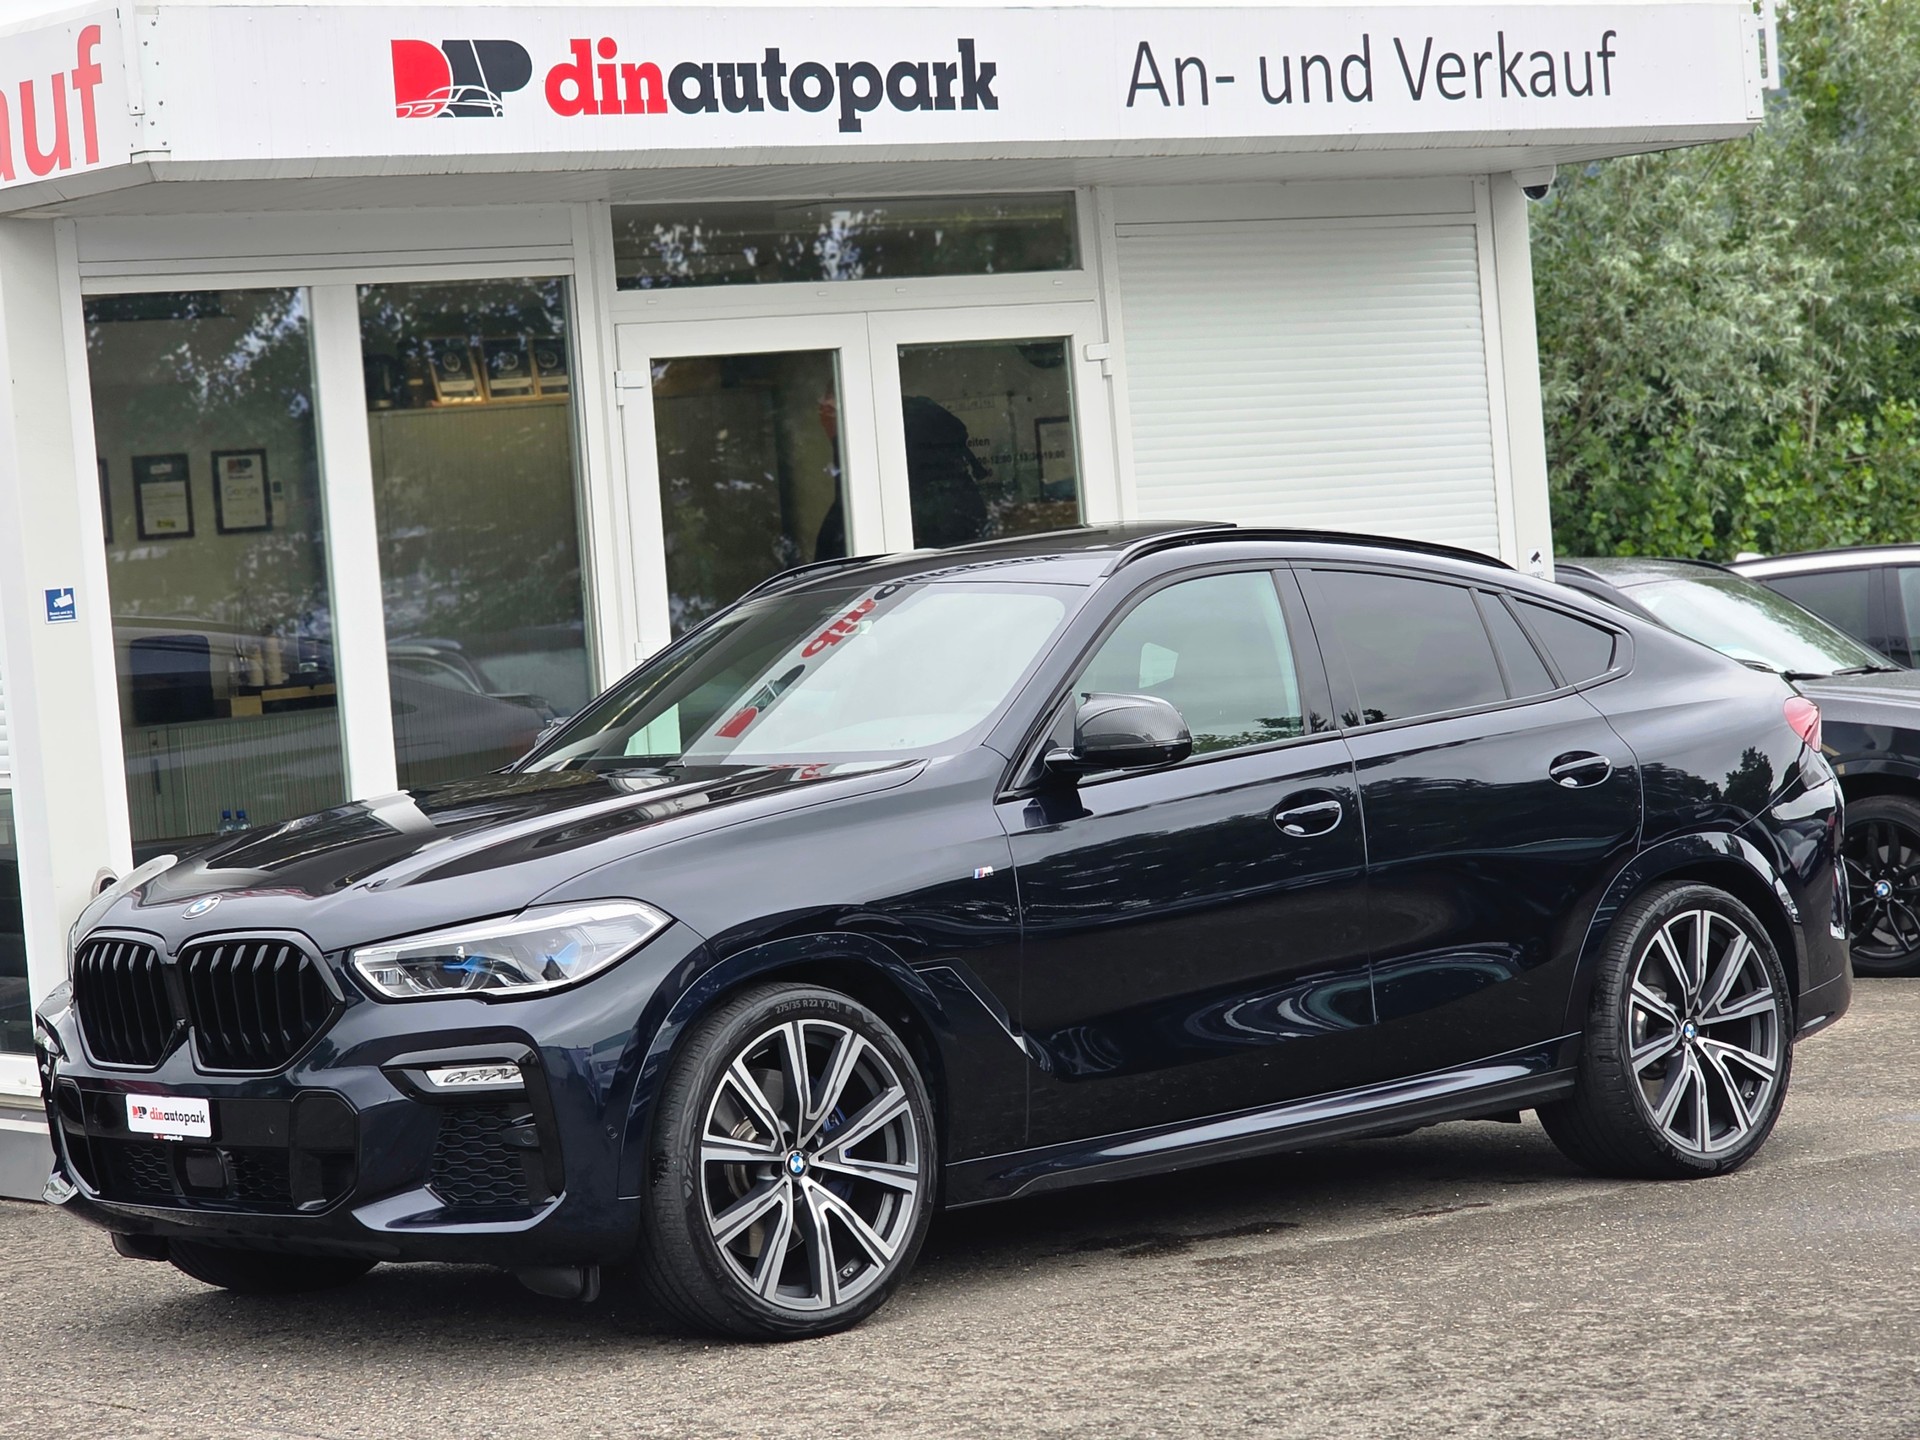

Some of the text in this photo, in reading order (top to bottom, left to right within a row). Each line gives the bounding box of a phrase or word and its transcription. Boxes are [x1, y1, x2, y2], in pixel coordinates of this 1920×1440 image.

[545, 36, 999, 133] dinautopark
[1126, 30, 1617, 107] An- und Verkauf
[775, 1000, 801, 1014] 275/35
[802, 1000, 809, 1008] R
[809, 999, 818, 1008] 22
[149, 1106, 206, 1126] dinautopark
